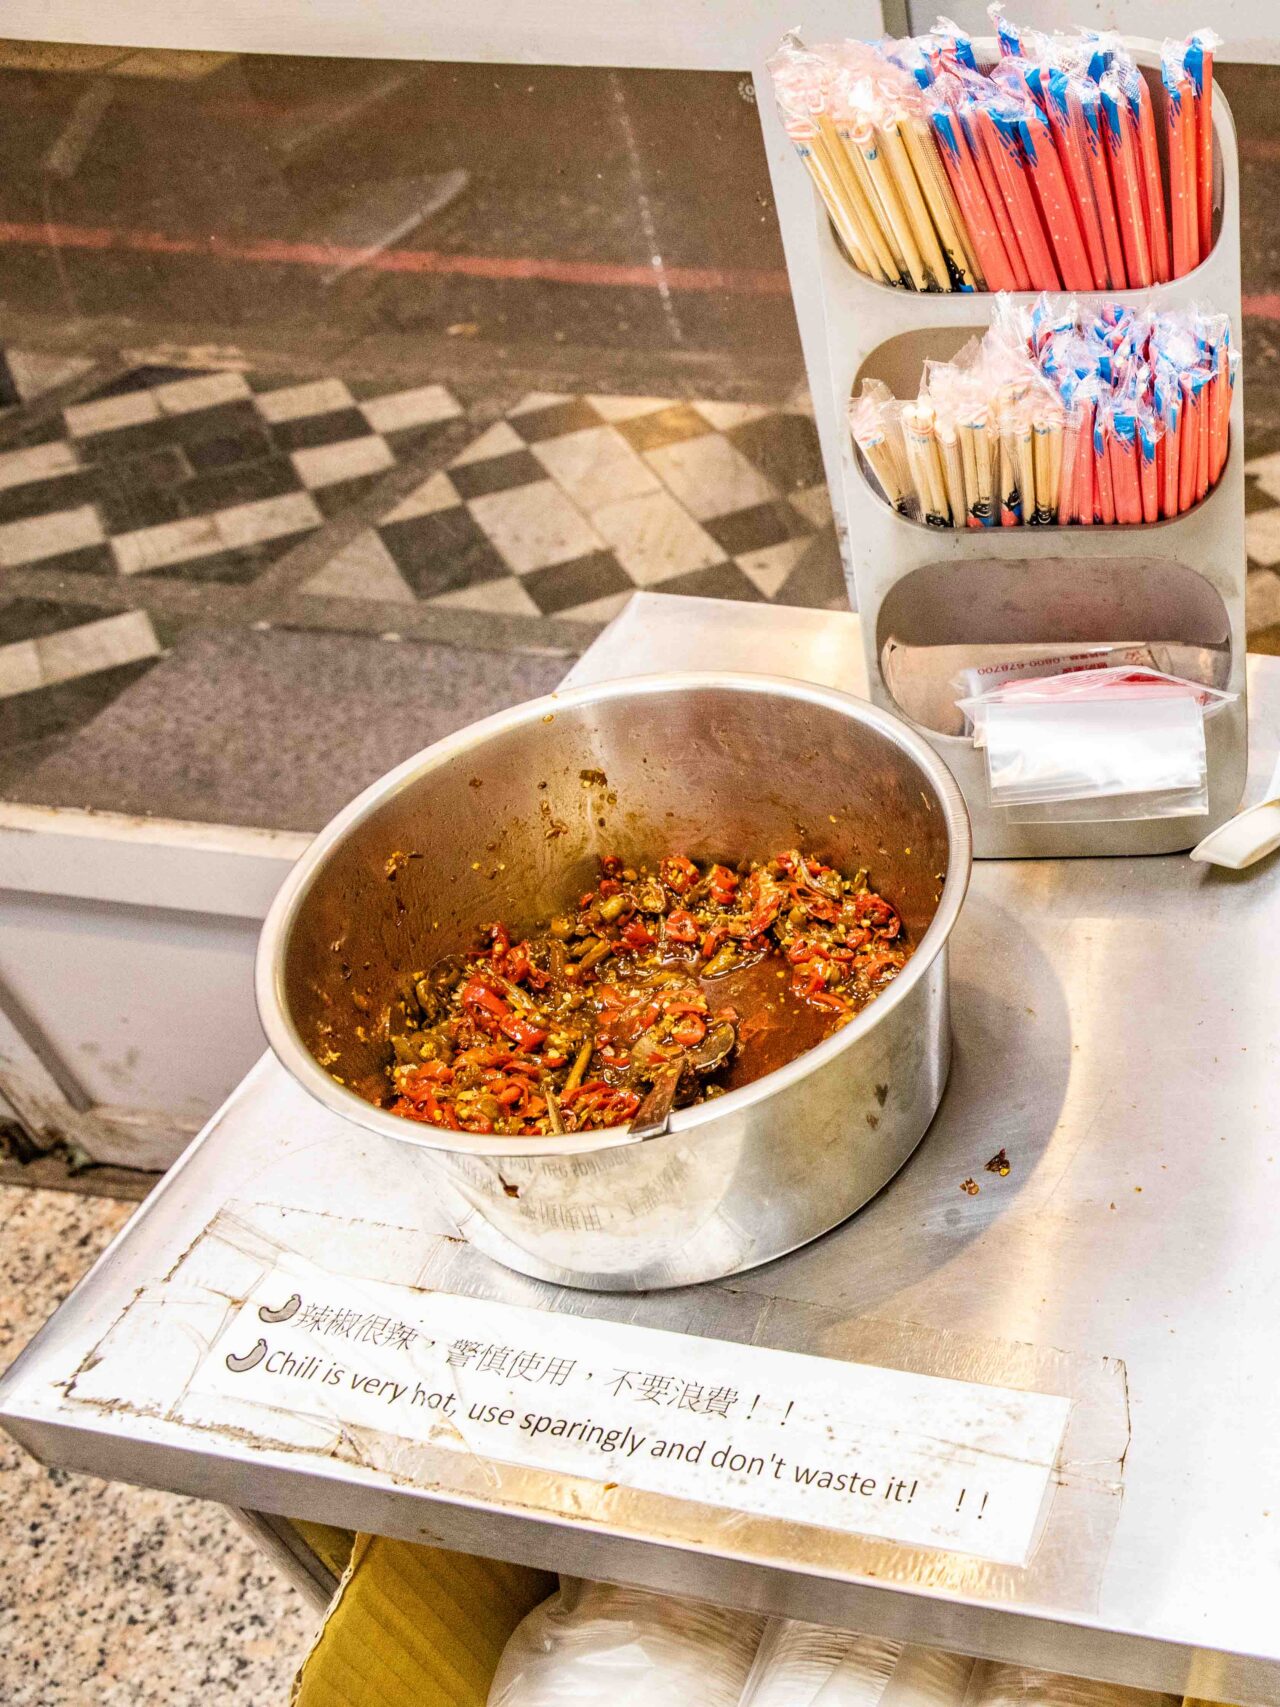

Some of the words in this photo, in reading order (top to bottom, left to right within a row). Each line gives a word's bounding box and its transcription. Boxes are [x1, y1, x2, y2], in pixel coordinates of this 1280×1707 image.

[265, 1350, 322, 1381] Chili
[322, 1362, 344, 1385] is
[350, 1373, 409, 1405] very
[410, 1382, 457, 1417] hot,
[468, 1402, 515, 1426] use
[519, 1411, 647, 1457] sparingly
[650, 1440, 706, 1464] and
[711, 1444, 787, 1480] don't
[794, 1463, 877, 1497] waste
[884, 1475, 919, 1505] it!
